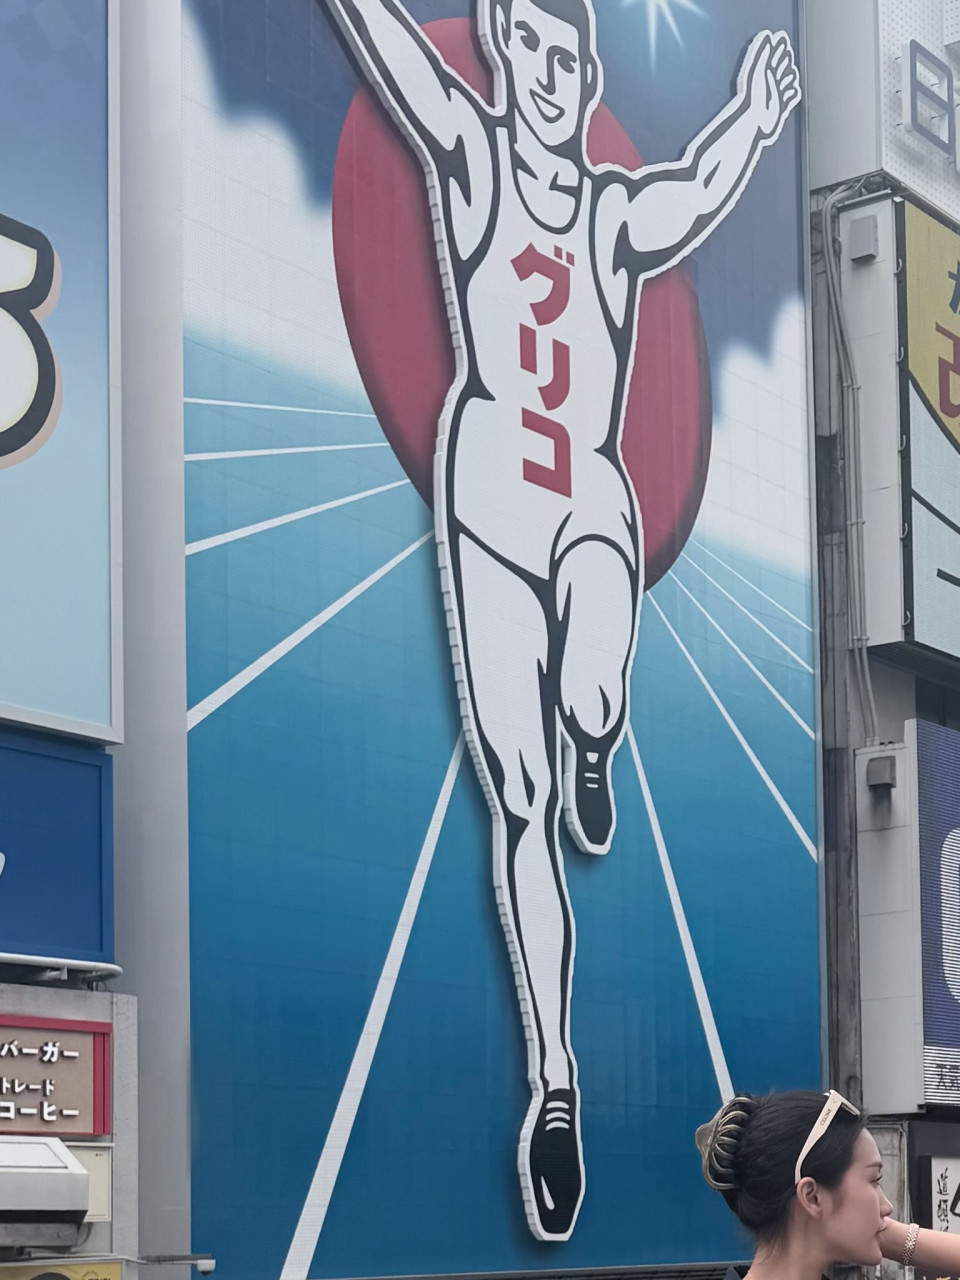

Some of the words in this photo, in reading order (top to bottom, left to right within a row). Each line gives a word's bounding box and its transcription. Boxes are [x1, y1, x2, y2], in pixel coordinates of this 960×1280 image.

[510, 242, 575, 499] グリコ
[0, 1040, 80, 1062] バーガー
[2, 1076, 56, 1096] トレード
[0, 1101, 80, 1121] コーヒー
